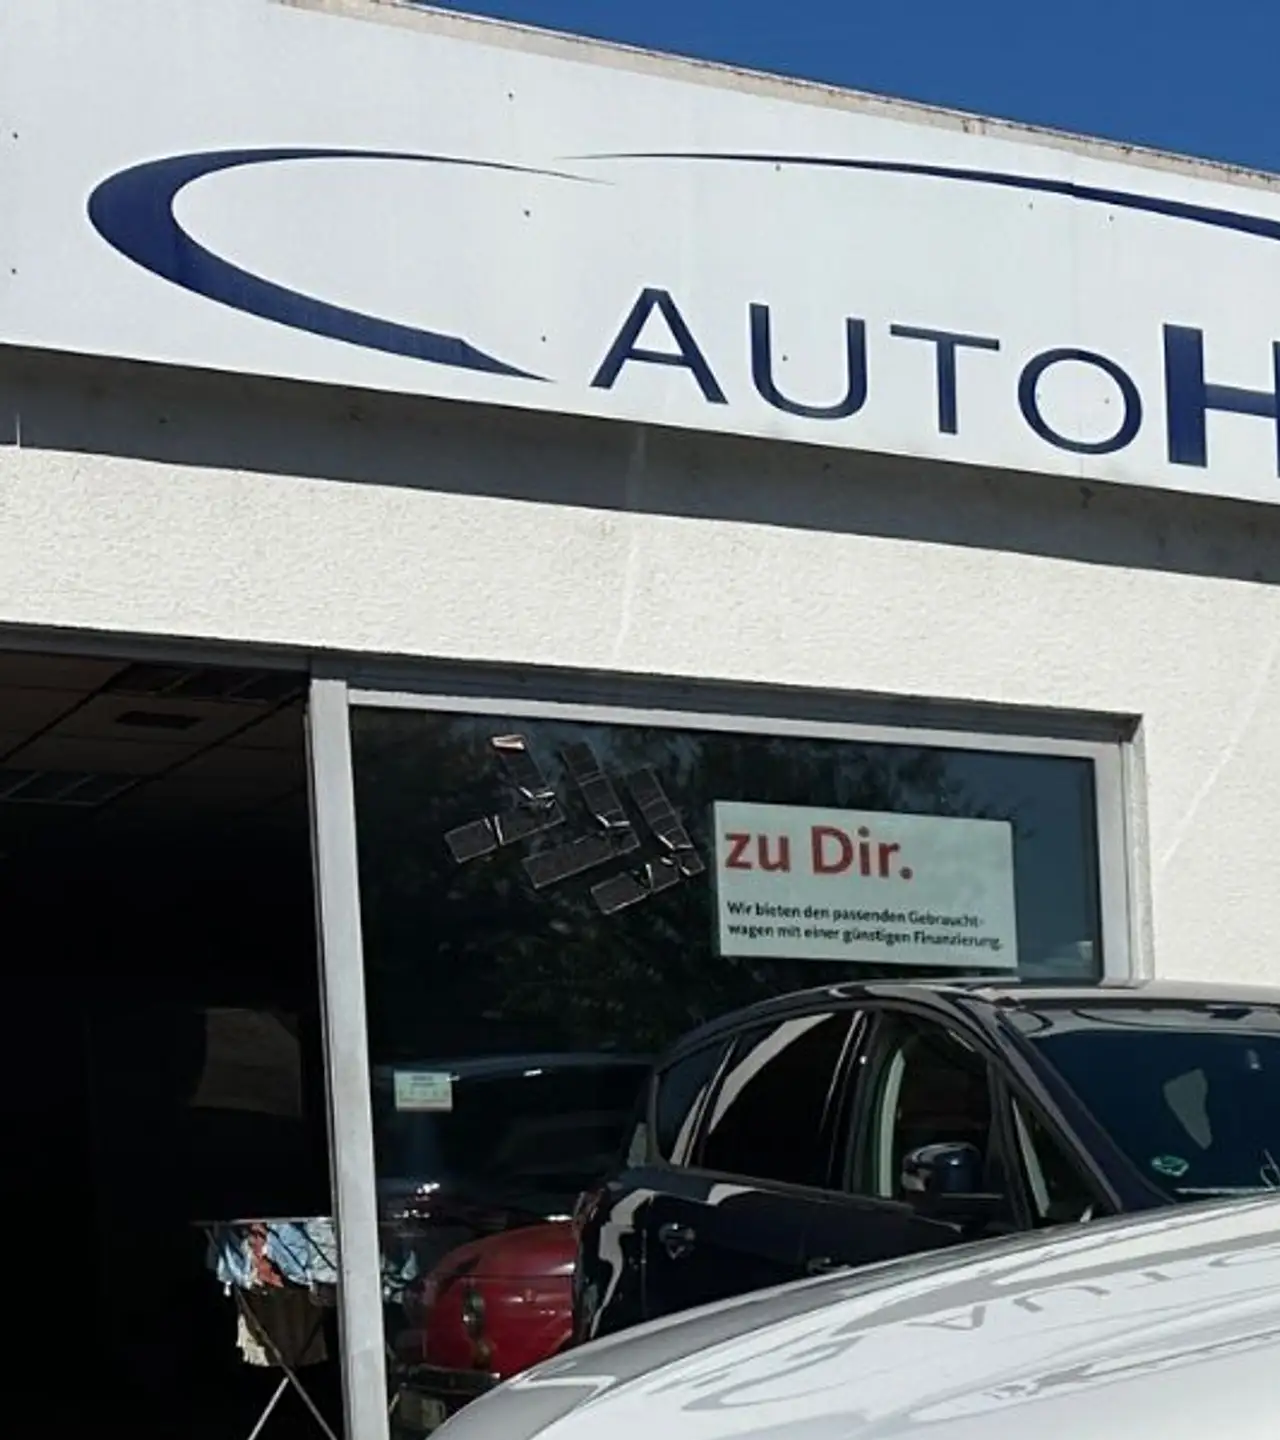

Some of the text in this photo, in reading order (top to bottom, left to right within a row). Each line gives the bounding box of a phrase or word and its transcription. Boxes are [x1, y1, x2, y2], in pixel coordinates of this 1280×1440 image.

[725, 825, 913, 880] zu Dir.
[727, 901, 751, 917] Wir
[755, 902, 801, 919] bieten
[804, 903, 830, 920] den
[833, 906, 906, 925] passenden
[728, 923, 1003, 951] wagen mit einer günstigen Finanzierung.
